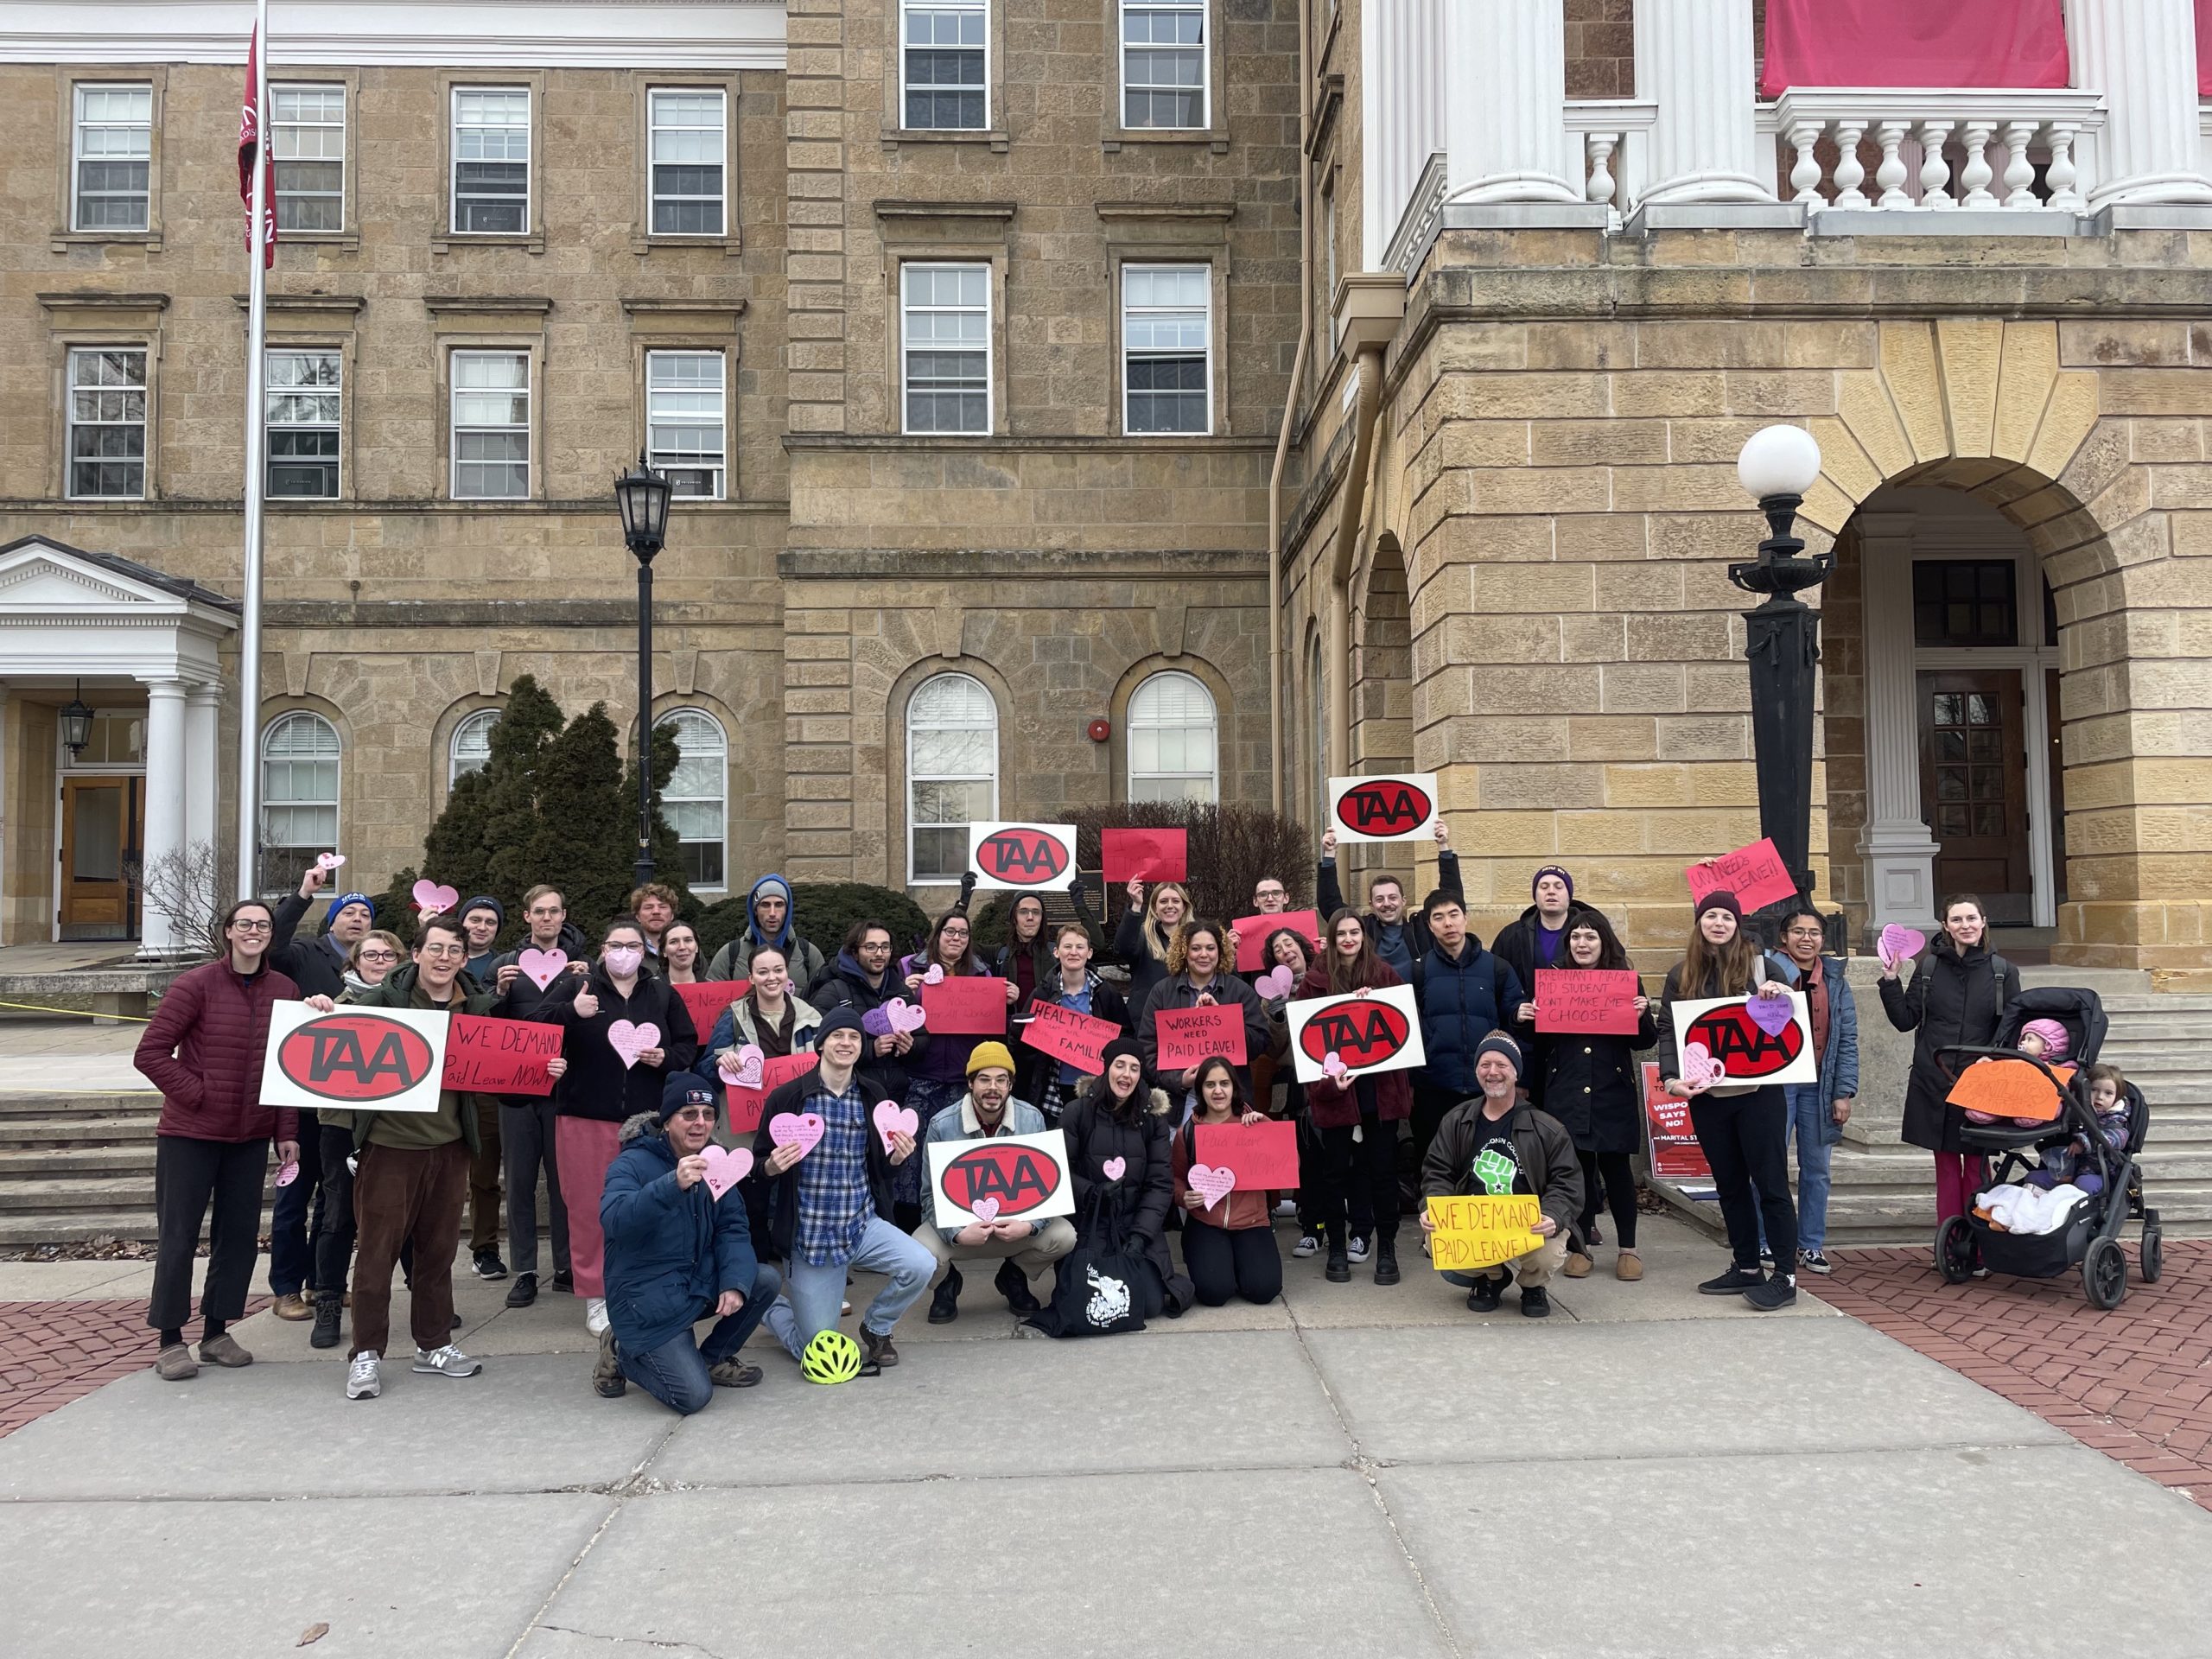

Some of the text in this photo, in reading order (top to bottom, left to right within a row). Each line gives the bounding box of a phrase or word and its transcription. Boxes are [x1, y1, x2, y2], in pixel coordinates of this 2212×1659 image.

[1345, 789, 1421, 826] TAA
[985, 837, 1058, 875] TAA
[1538, 970, 1630, 982] PREGNANT MAMA
[1561, 983, 1609, 994] STUDENT
[1569, 996, 1599, 1007] MAKE
[1605, 997, 1625, 1007] ME
[1166, 1015, 1222, 1031] WORKERS
[1548, 1009, 1609, 1022] CHOOSE
[457, 1023, 563, 1055] WE DEMAND
[1184, 1030, 1208, 1039] NEED
[1308, 1009, 1399, 1055] TAA
[1694, 1018, 1792, 1065] TAA
[298, 1027, 413, 1087] TAA
[1167, 1040, 1235, 1058] PAID LEAVE!
[472, 1061, 506, 1085] Leave
[1653, 1102, 1688, 1112] WISPO
[1659, 1110, 1686, 1120] SAYS
[1665, 1119, 1684, 1128] NO!
[951, 1154, 1050, 1205] TAA
[1431, 1202, 1540, 1230] WE DEMAND
[1433, 1237, 1469, 1267] PAID
